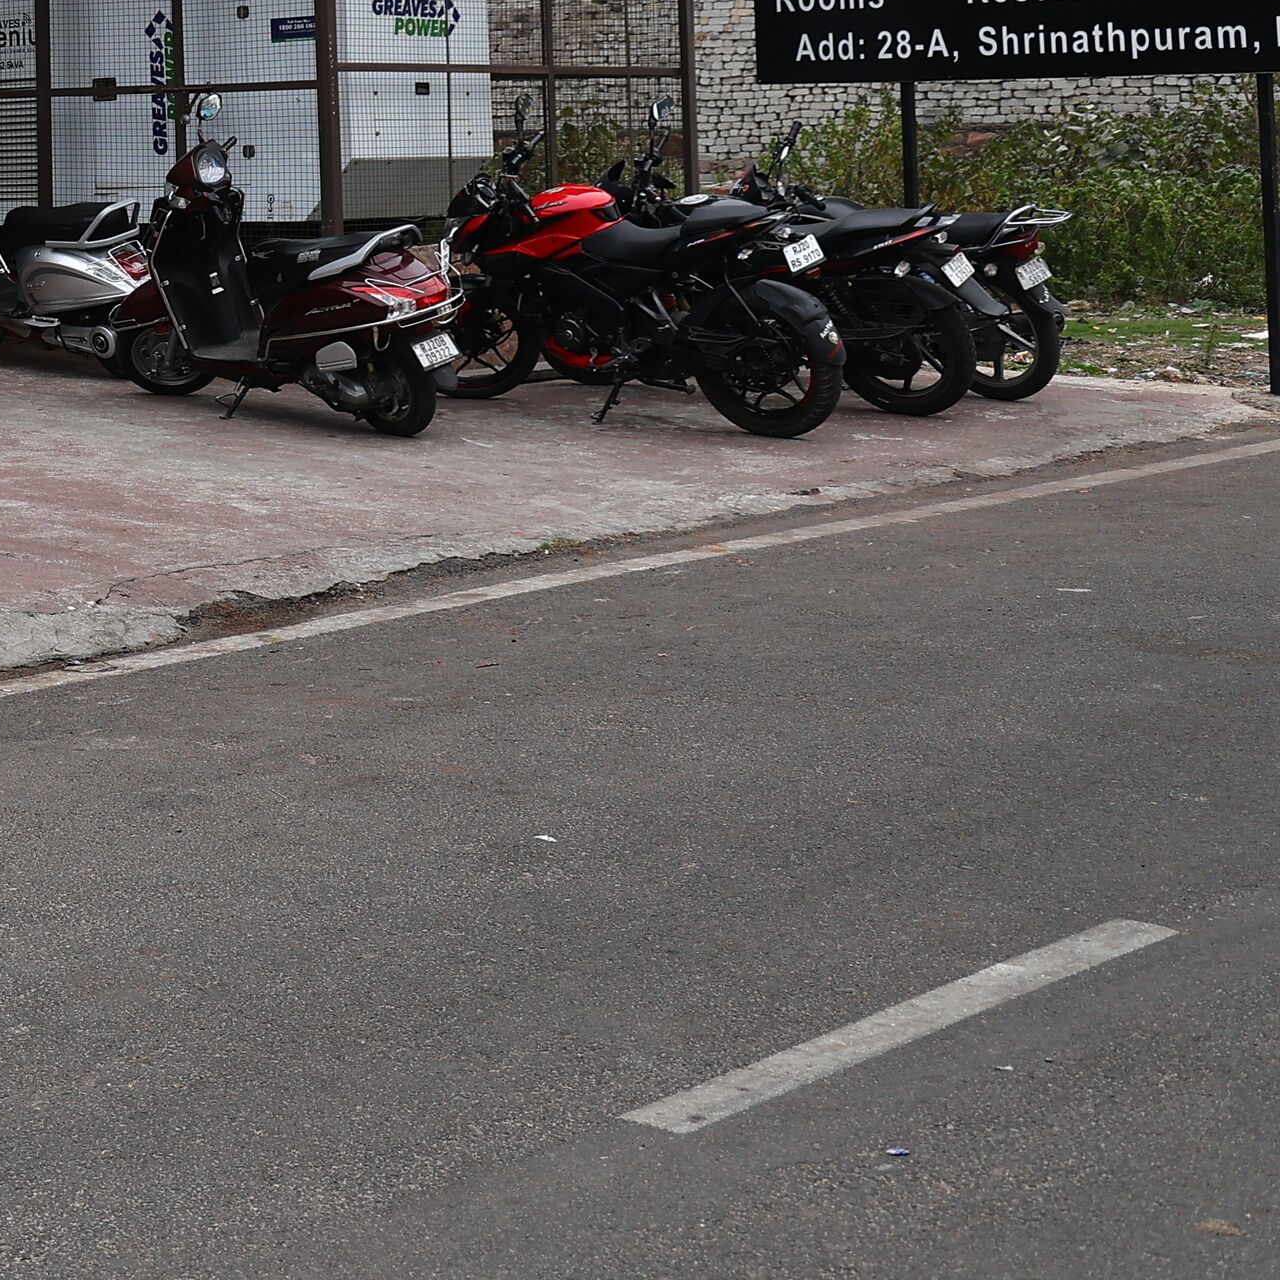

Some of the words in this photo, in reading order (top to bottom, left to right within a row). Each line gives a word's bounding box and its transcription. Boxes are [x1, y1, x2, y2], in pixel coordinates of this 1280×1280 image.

[394, 17, 448, 37] POWER
[795, 31, 866, 62] Add:
[877, 28, 960, 63] 28-A,
[978, 21, 1261, 59] Shrinathpuram,
[149, 50, 168, 156] GREAVES
[790, 257, 802, 269] RS
[803, 248, 821, 264] 9170
[792, 240, 810, 256] RJ20
